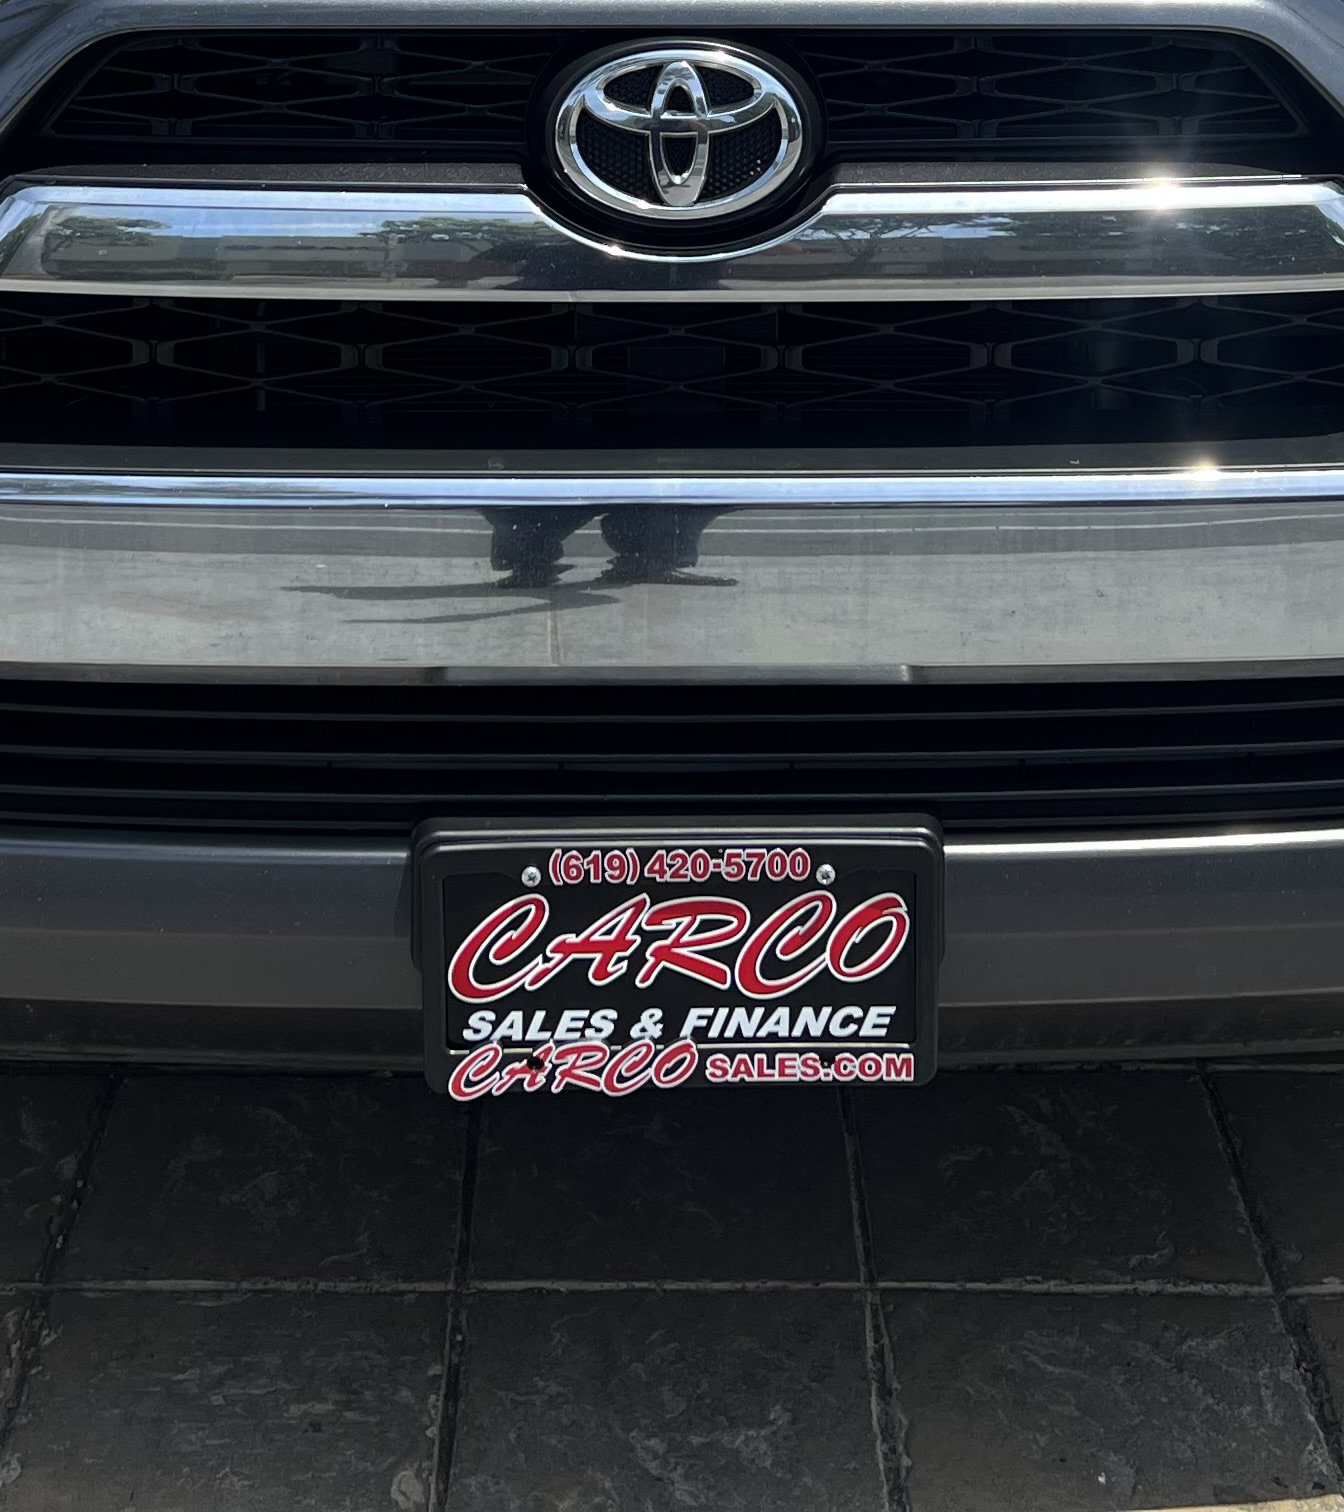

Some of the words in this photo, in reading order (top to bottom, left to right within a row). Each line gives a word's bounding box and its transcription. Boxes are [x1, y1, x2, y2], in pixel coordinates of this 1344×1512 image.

[549, 849, 640, 886] (619)
[645, 848, 812, 883] 420-5700
[448, 890, 910, 1002] CARCO
[462, 1007, 616, 1042] SALES
[630, 1007, 664, 1040] &
[682, 1006, 897, 1039] FINANCE
[448, 1040, 699, 1101] CARCO
[705, 1053, 915, 1082] SALES.COM
